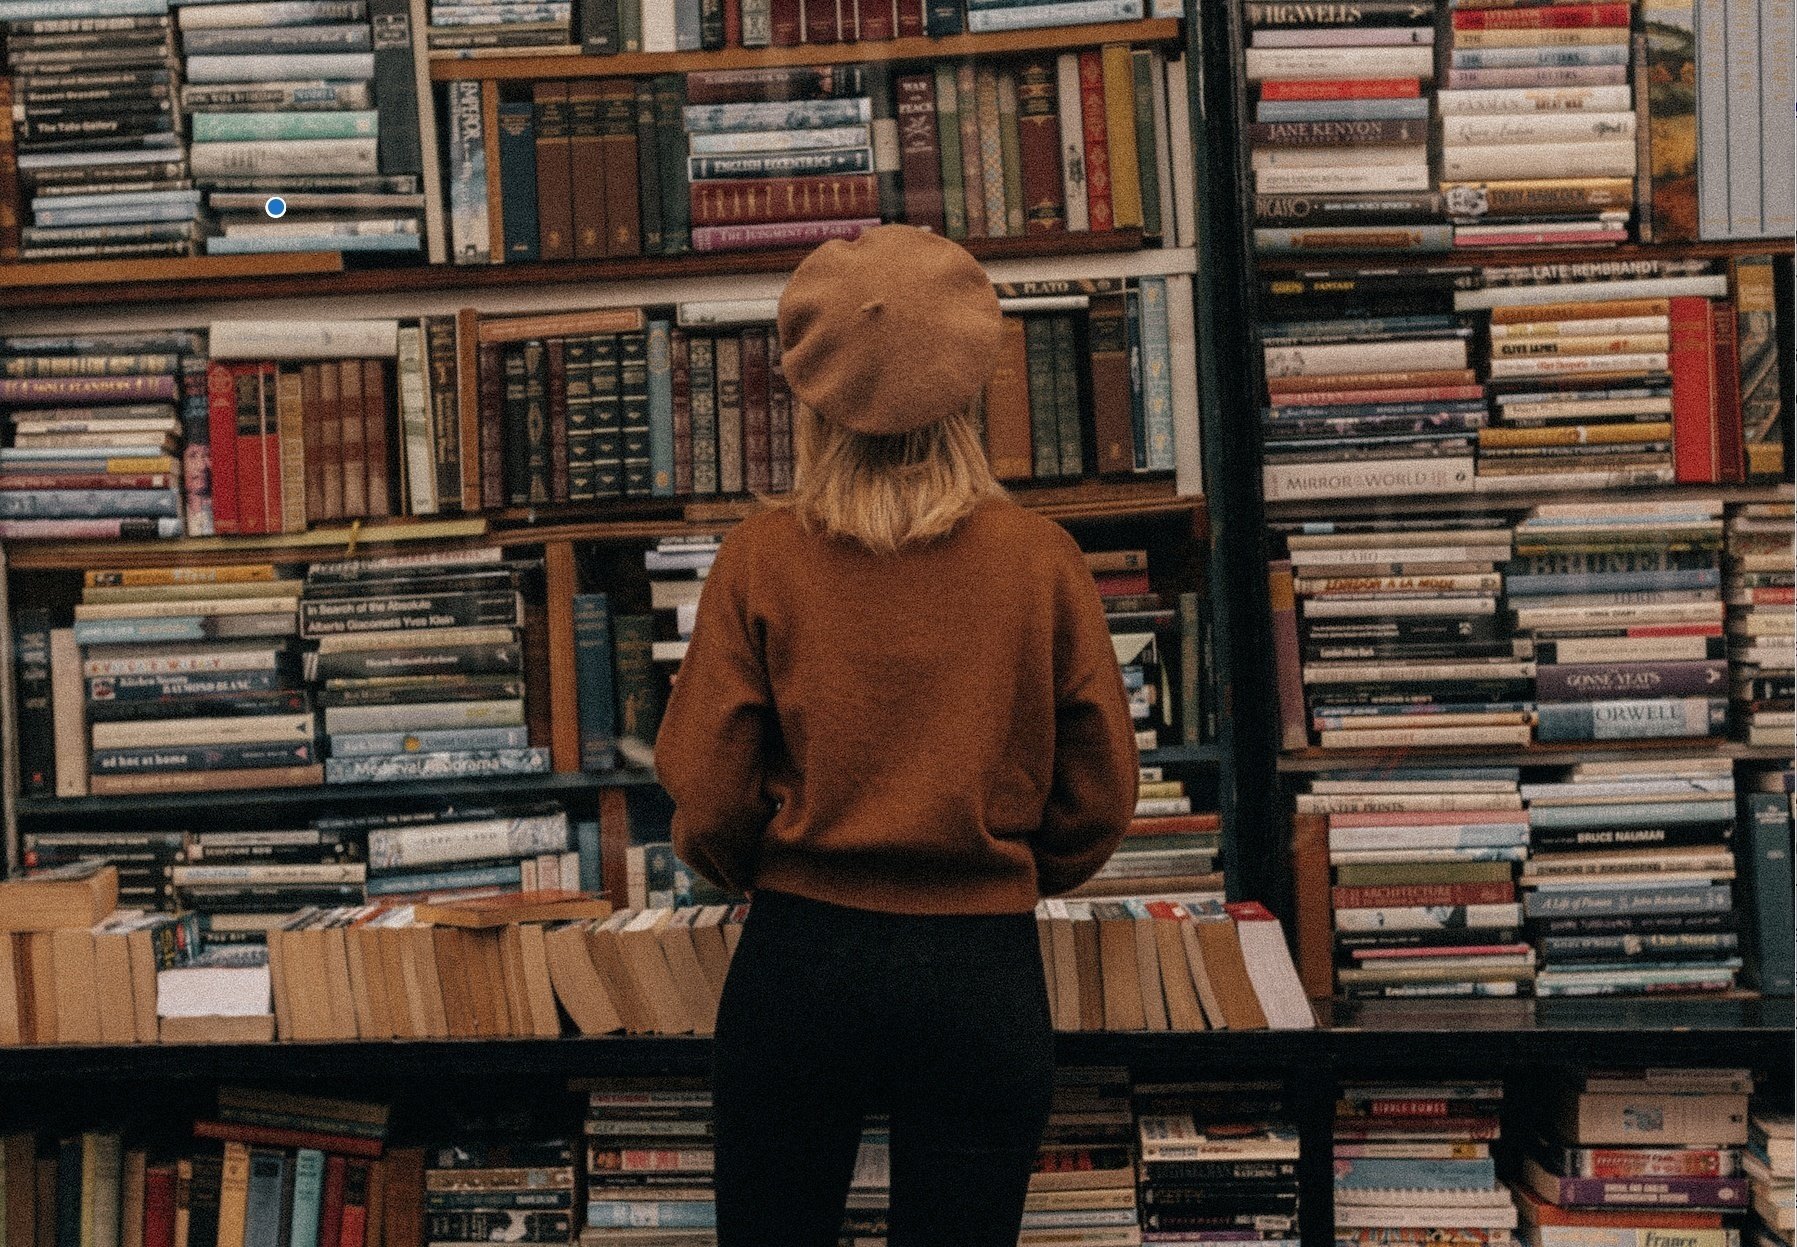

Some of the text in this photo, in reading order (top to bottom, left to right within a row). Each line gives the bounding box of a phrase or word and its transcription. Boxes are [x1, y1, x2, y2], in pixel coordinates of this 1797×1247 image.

[1295, 3, 1363, 24] WELLS
[902, 82, 928, 92] WAR
[900, 103, 934, 114] PEACE
[1267, 121, 1383, 141] JANE KENYON
[1256, 197, 1311, 218] PICASSO
[719, 229, 743, 243] THE
[745, 226, 802, 243] JUDGMENT
[1531, 260, 1660, 281] LATE REMBRANDT
[1022, 281, 1070, 294] PLATO
[1313, 281, 1356, 291] FANTASY
[1501, 343, 1559, 354] CLIVE JAMES
[1286, 473, 1352, 491] MIRROR
[1364, 471, 1428, 488] WORLD
[1325, 579, 1383, 592] LONDON
[306, 599, 432, 615] In Search of the Absolute
[1612, 610, 1637, 618] DIARY
[307, 619, 345, 633] Alberto
[402, 617, 428, 628] Yves
[1594, 704, 1682, 723] ORWELL
[102, 753, 188, 768] ad hoc at home
[353, 759, 422, 777] Medieval
[1577, 829, 1665, 844] BRUCE NAUMAN
[1362, 885, 1450, 898] ARCHITECTURE
[1644, 1230, 1698, 1247] France
